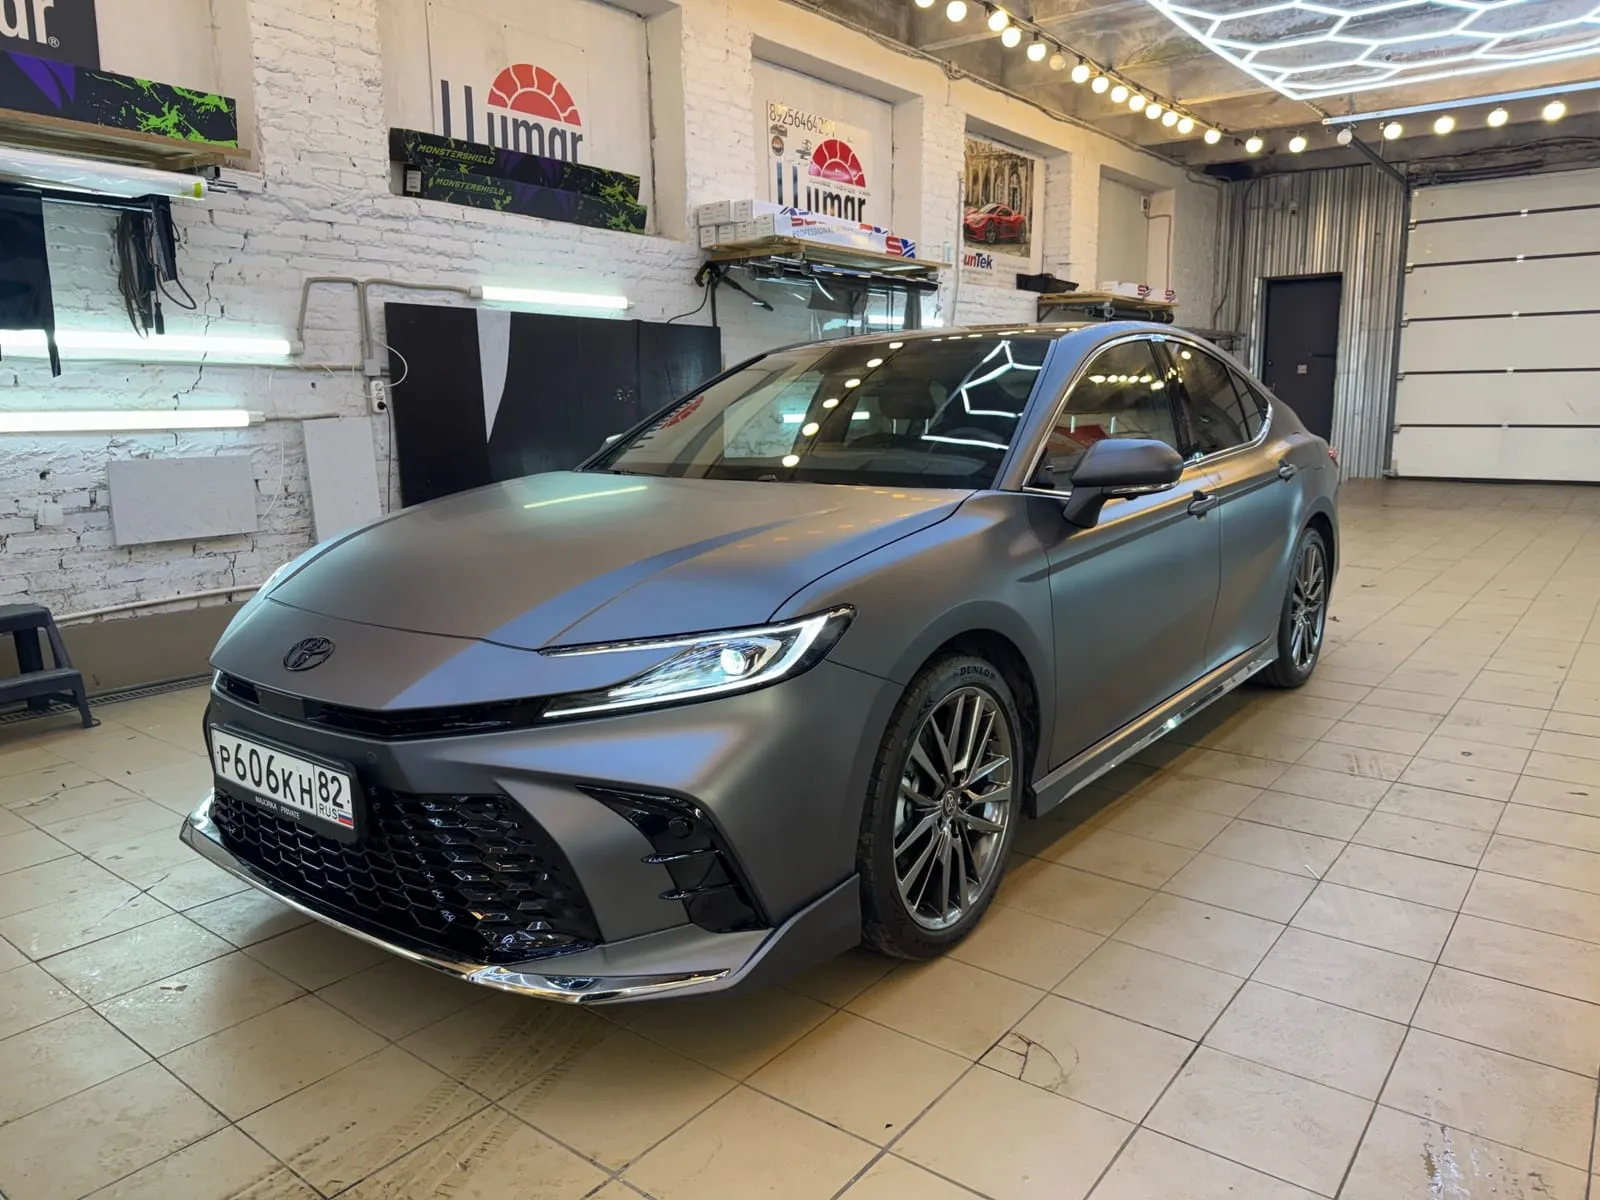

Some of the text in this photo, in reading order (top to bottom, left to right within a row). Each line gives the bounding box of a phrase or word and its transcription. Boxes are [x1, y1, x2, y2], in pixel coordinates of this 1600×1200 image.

[417, 144, 496, 165] MONSTERSHIELD
[434, 178, 505, 196] MONSTERSHIELD
[963, 252, 993, 270] unTek
[960, 665, 996, 680] DUNLOP
[317, 770, 344, 809] 82
[280, 805, 301, 820] PRIVATE
[319, 803, 338, 820] RUS
